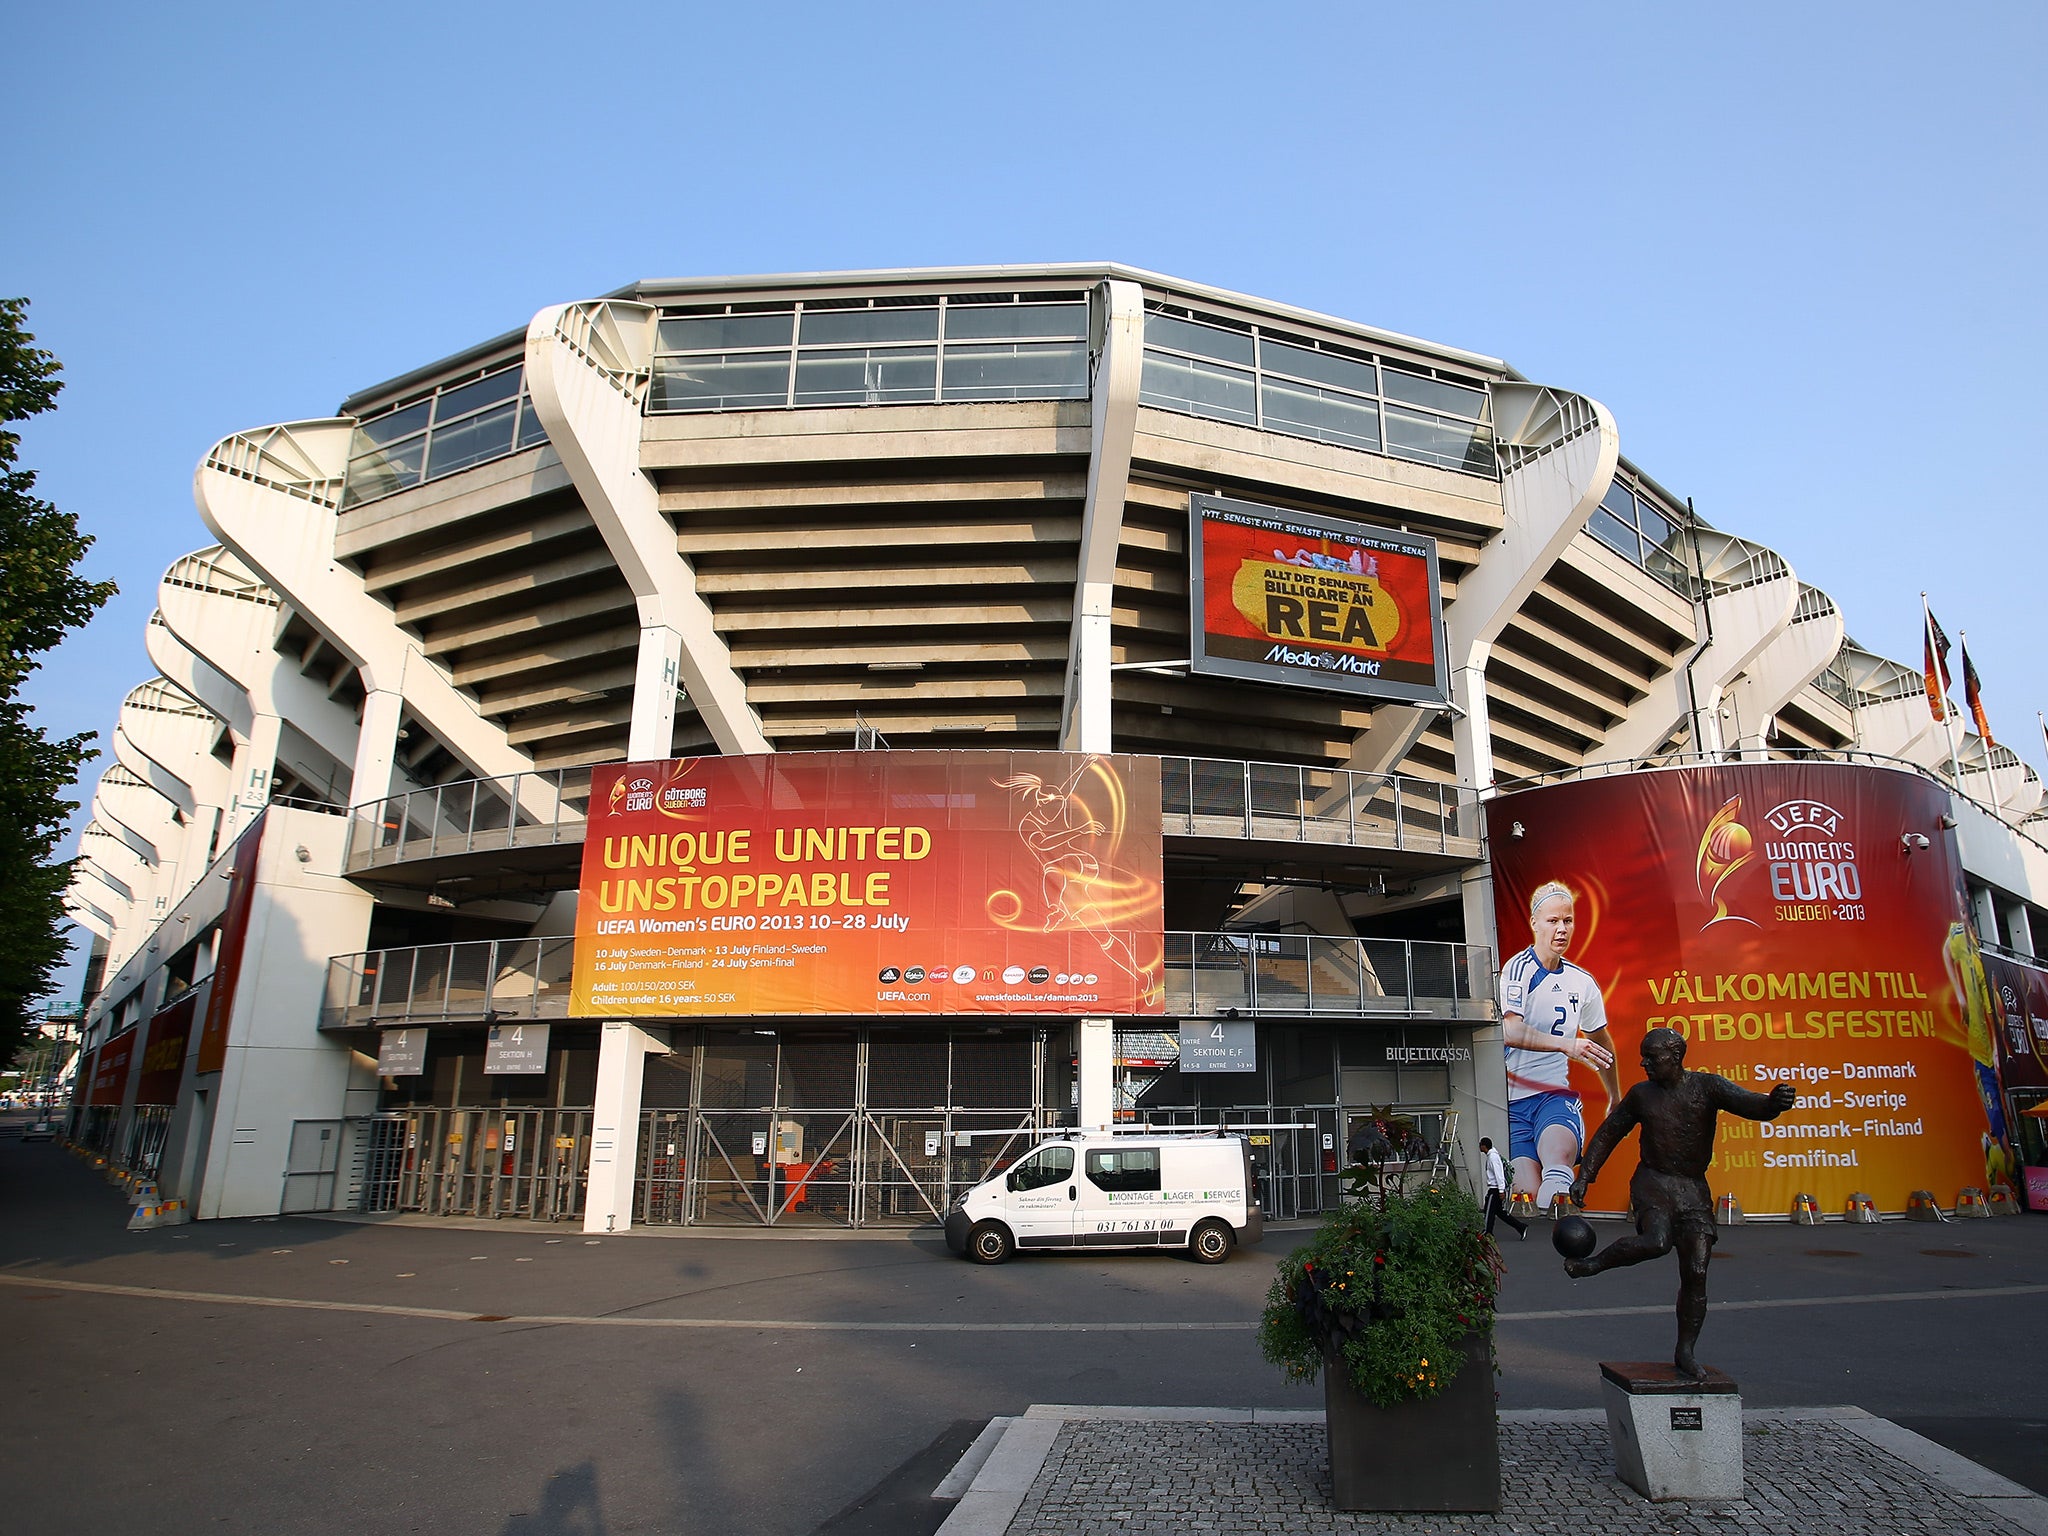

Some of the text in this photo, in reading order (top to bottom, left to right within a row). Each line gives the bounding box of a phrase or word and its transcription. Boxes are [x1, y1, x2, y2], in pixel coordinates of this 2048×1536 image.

[1223, 513, 1260, 527] SENASTE
[1262, 520, 1284, 532] NYTT.
[1285, 524, 1321, 538] SENASTE
[1323, 531, 1343, 542] NYTT.
[1345, 535, 1379, 549] SENASTE
[1380, 541, 1400, 552] NYTT.
[1401, 545, 1426, 557] SENAS
[1264, 569, 1373, 593] ALLT DET SENASTE.
[1265, 580, 1374, 607] BILLIGARE ÄN
[1266, 594, 1378, 647] REA
[1264, 644, 1381, 676] Media Markt
[664, 657, 676, 687] H
[250, 768, 267, 789] H
[630, 780, 653, 791] UEFA
[664, 799, 706, 808] SWEDEN 2013
[665, 788, 707, 801] GÖTEBORG
[626, 798, 653, 811] EURO
[1769, 805, 1838, 833] UEFA
[603, 827, 931, 874] UNIQUE UNITED
[1765, 842, 1855, 860] WOMEN'S
[1769, 861, 1862, 900] EURO
[599, 872, 891, 913] UNSTOPPABLE
[155, 896, 167, 909] H
[1774, 904, 1866, 921] SWEDEN 2013
[597, 919, 636, 935] UEFA
[639, 917, 707, 933] Women's
[710, 915, 757, 931] EURO
[759, 915, 804, 930] 2013
[870, 913, 910, 933] July
[595, 949, 608, 958] 10
[608, 948, 629, 959] July
[715, 946, 728, 955] 13
[730, 944, 751, 956] July
[594, 962, 606, 971] 16
[607, 961, 627, 972] July
[711, 959, 725, 968] 24
[727, 958, 748, 970] July
[749, 957, 795, 968] Semi-final
[592, 980, 696, 992] Adult: 100/150/200 SEK
[1647, 969, 1927, 1004] VÄLKOMMEN TILL
[591, 993, 735, 1005] Children under 16 years: 50 SEK
[877, 991, 931, 1001] UEFA.com
[1550, 1006, 1567, 1036] 2
[397, 1030, 408, 1048] 4
[511, 1026, 524, 1046] 4
[1210, 1022, 1225, 1043] 4
[499, 1050, 526, 1059] SEKTION
[1193, 1048, 1226, 1057] SEKTION
[1721, 1121, 1755, 1144] juli
[1723, 1150, 1757, 1172] juli
[1762, 1149, 1859, 1169] Semifinal
[1113, 1192, 1154, 1201] MONTAGE
[1167, 1191, 1194, 1200] LAGER
[1208, 1190, 1241, 1199] SERVICE
[1097, 1218, 1174, 1233] 031 761 81 00
